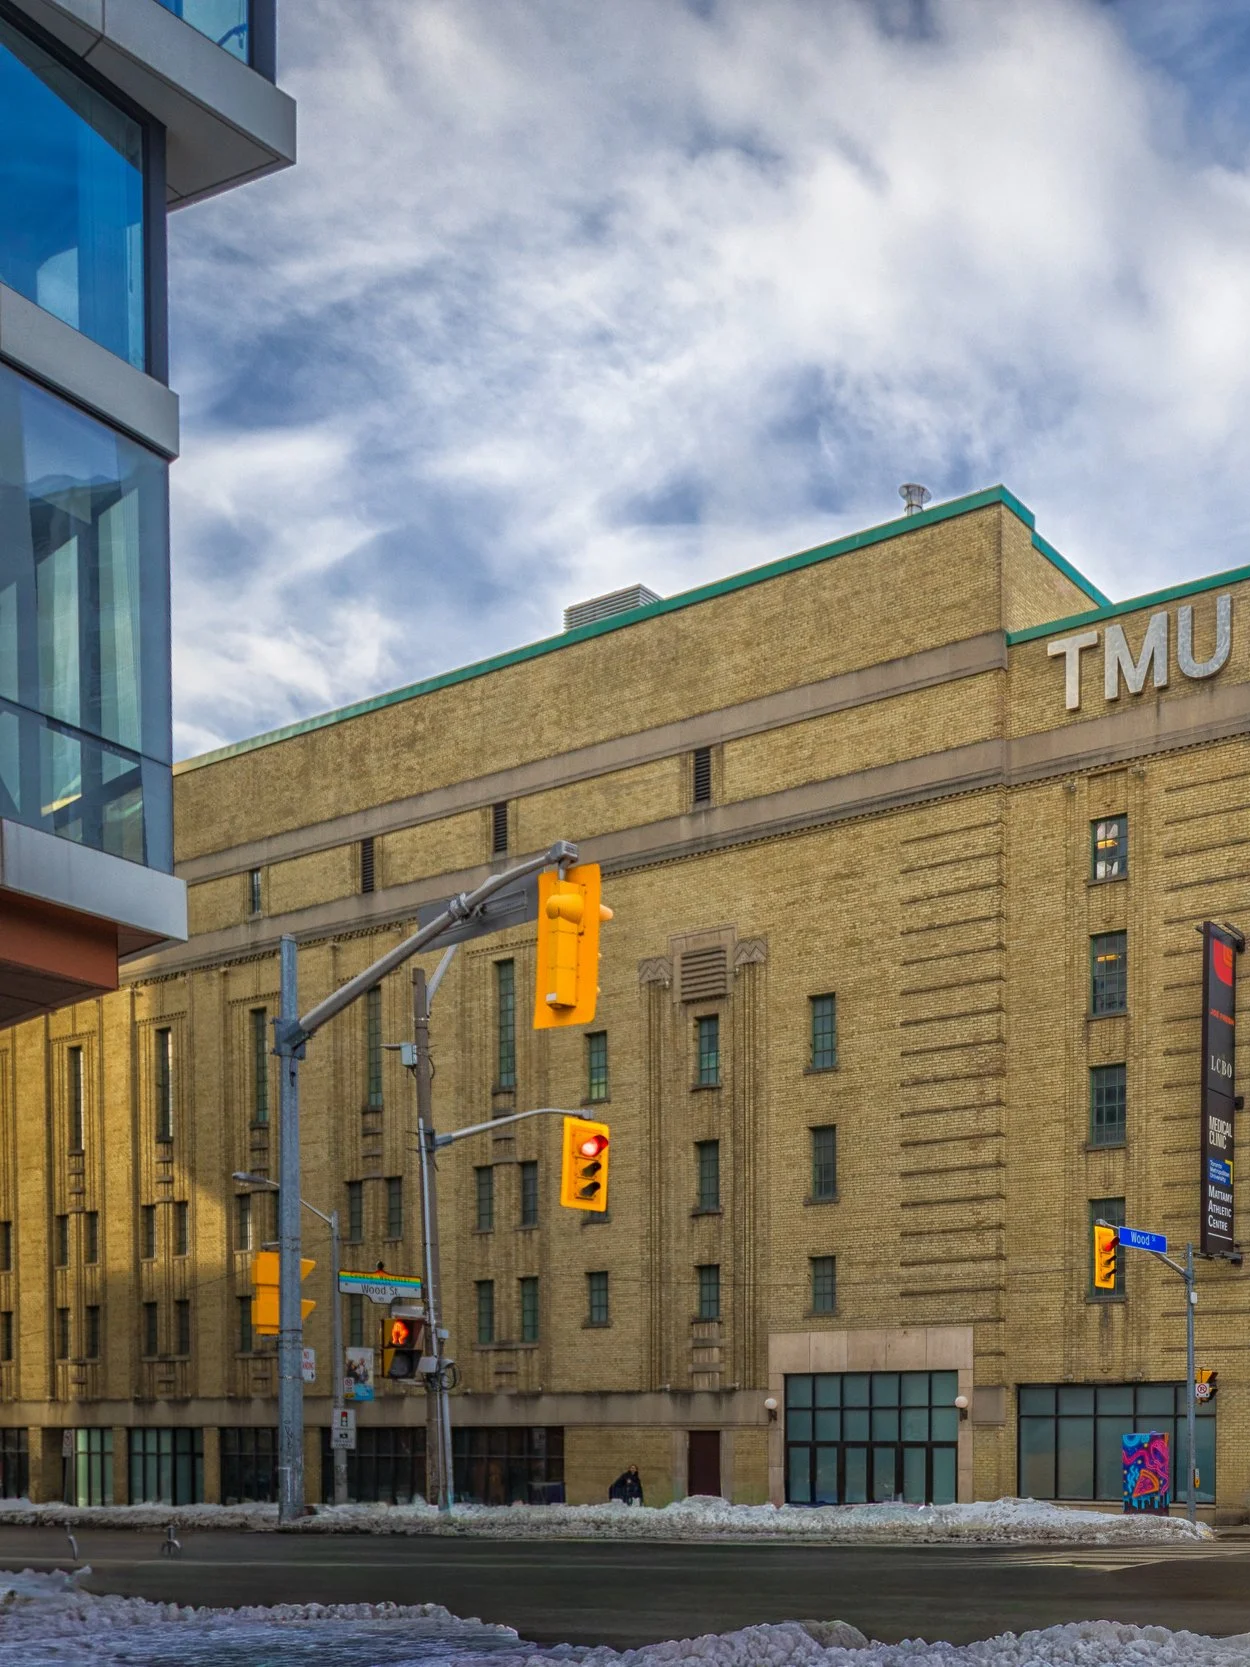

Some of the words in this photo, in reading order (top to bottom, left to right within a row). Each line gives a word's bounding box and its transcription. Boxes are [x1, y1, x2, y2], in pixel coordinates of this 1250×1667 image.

[1047, 593, 1232, 710] TMU
[1210, 1055, 1233, 1079] LCBO
[1209, 1115, 1233, 1138] MEDICAL
[1209, 1130, 1227, 1150] CLINIC
[1208, 1184, 1233, 1203] MATTAMY
[1208, 1200, 1232, 1218] ATHLETIC
[1208, 1215, 1228, 1231] CENTRE
[1130, 1231, 1150, 1246] Wood
[361, 1284, 386, 1296] Wood
